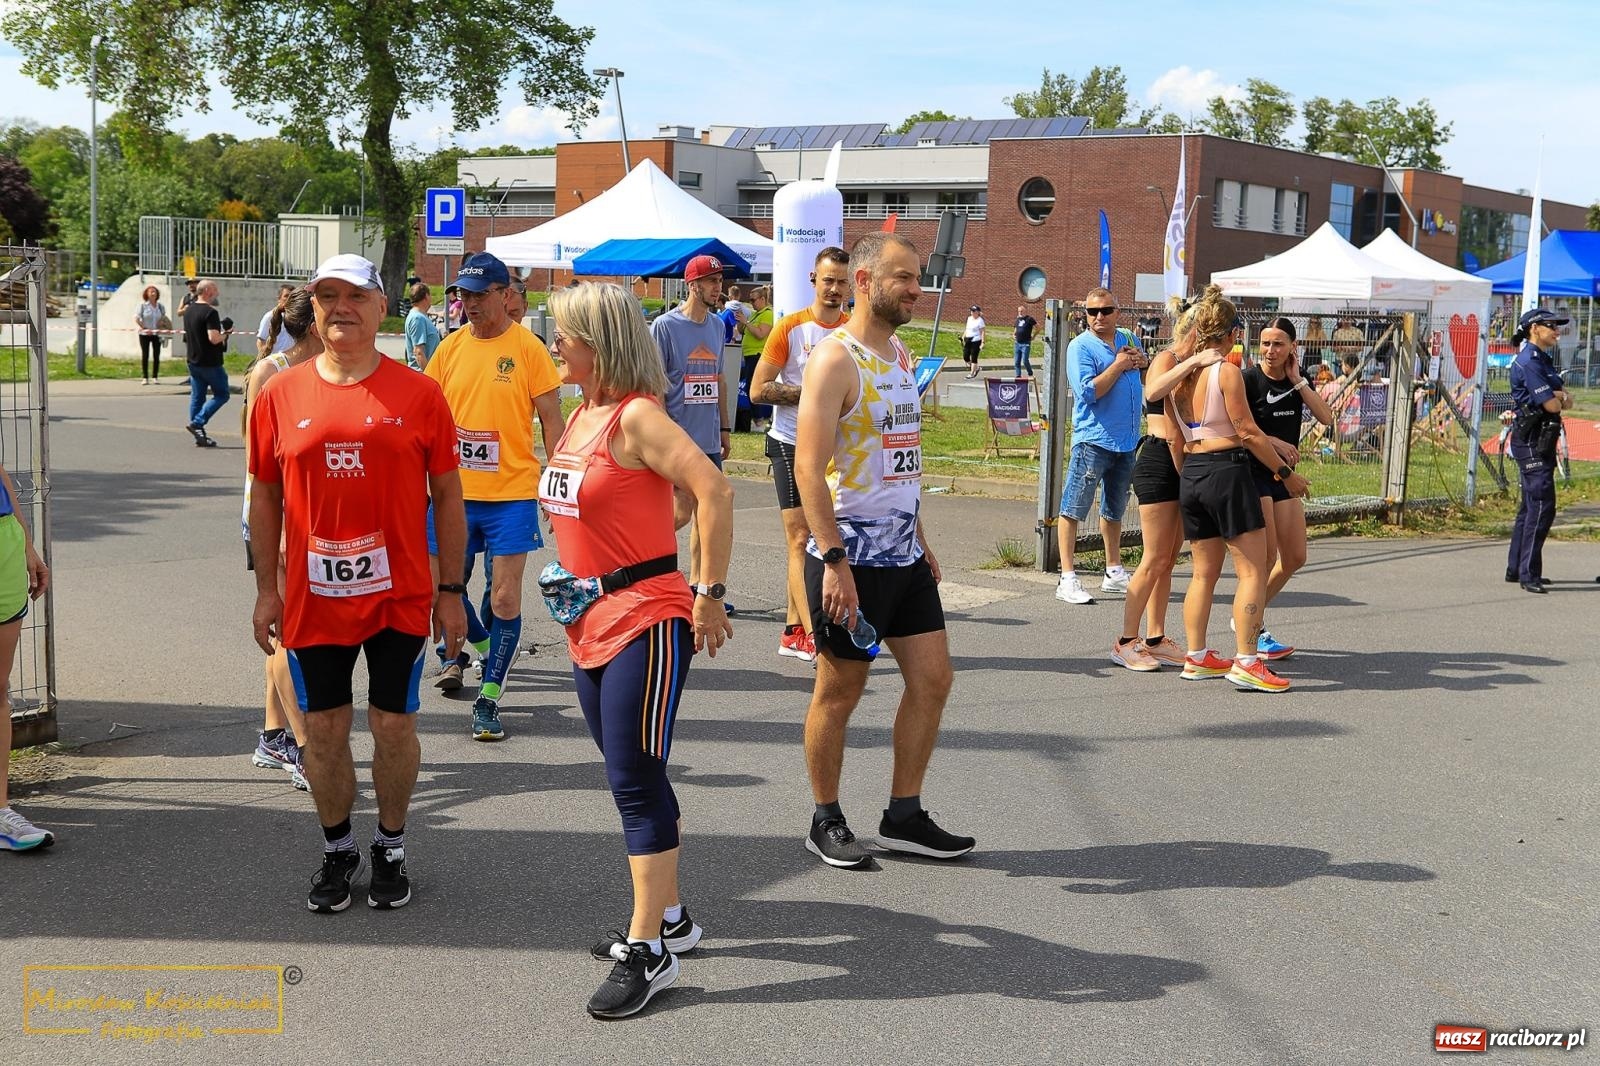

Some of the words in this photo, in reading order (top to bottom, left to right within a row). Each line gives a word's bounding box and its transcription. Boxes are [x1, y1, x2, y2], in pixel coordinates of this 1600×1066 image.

[434, 194, 456, 232] P
[785, 228, 826, 237] Wodociągi
[692, 383, 713, 397] 216
[326, 450, 363, 470] bbl
[893, 449, 920, 473] 233
[547, 470, 569, 499] 175
[352, 536, 375, 548] GRANIC
[322, 556, 374, 582] 162
